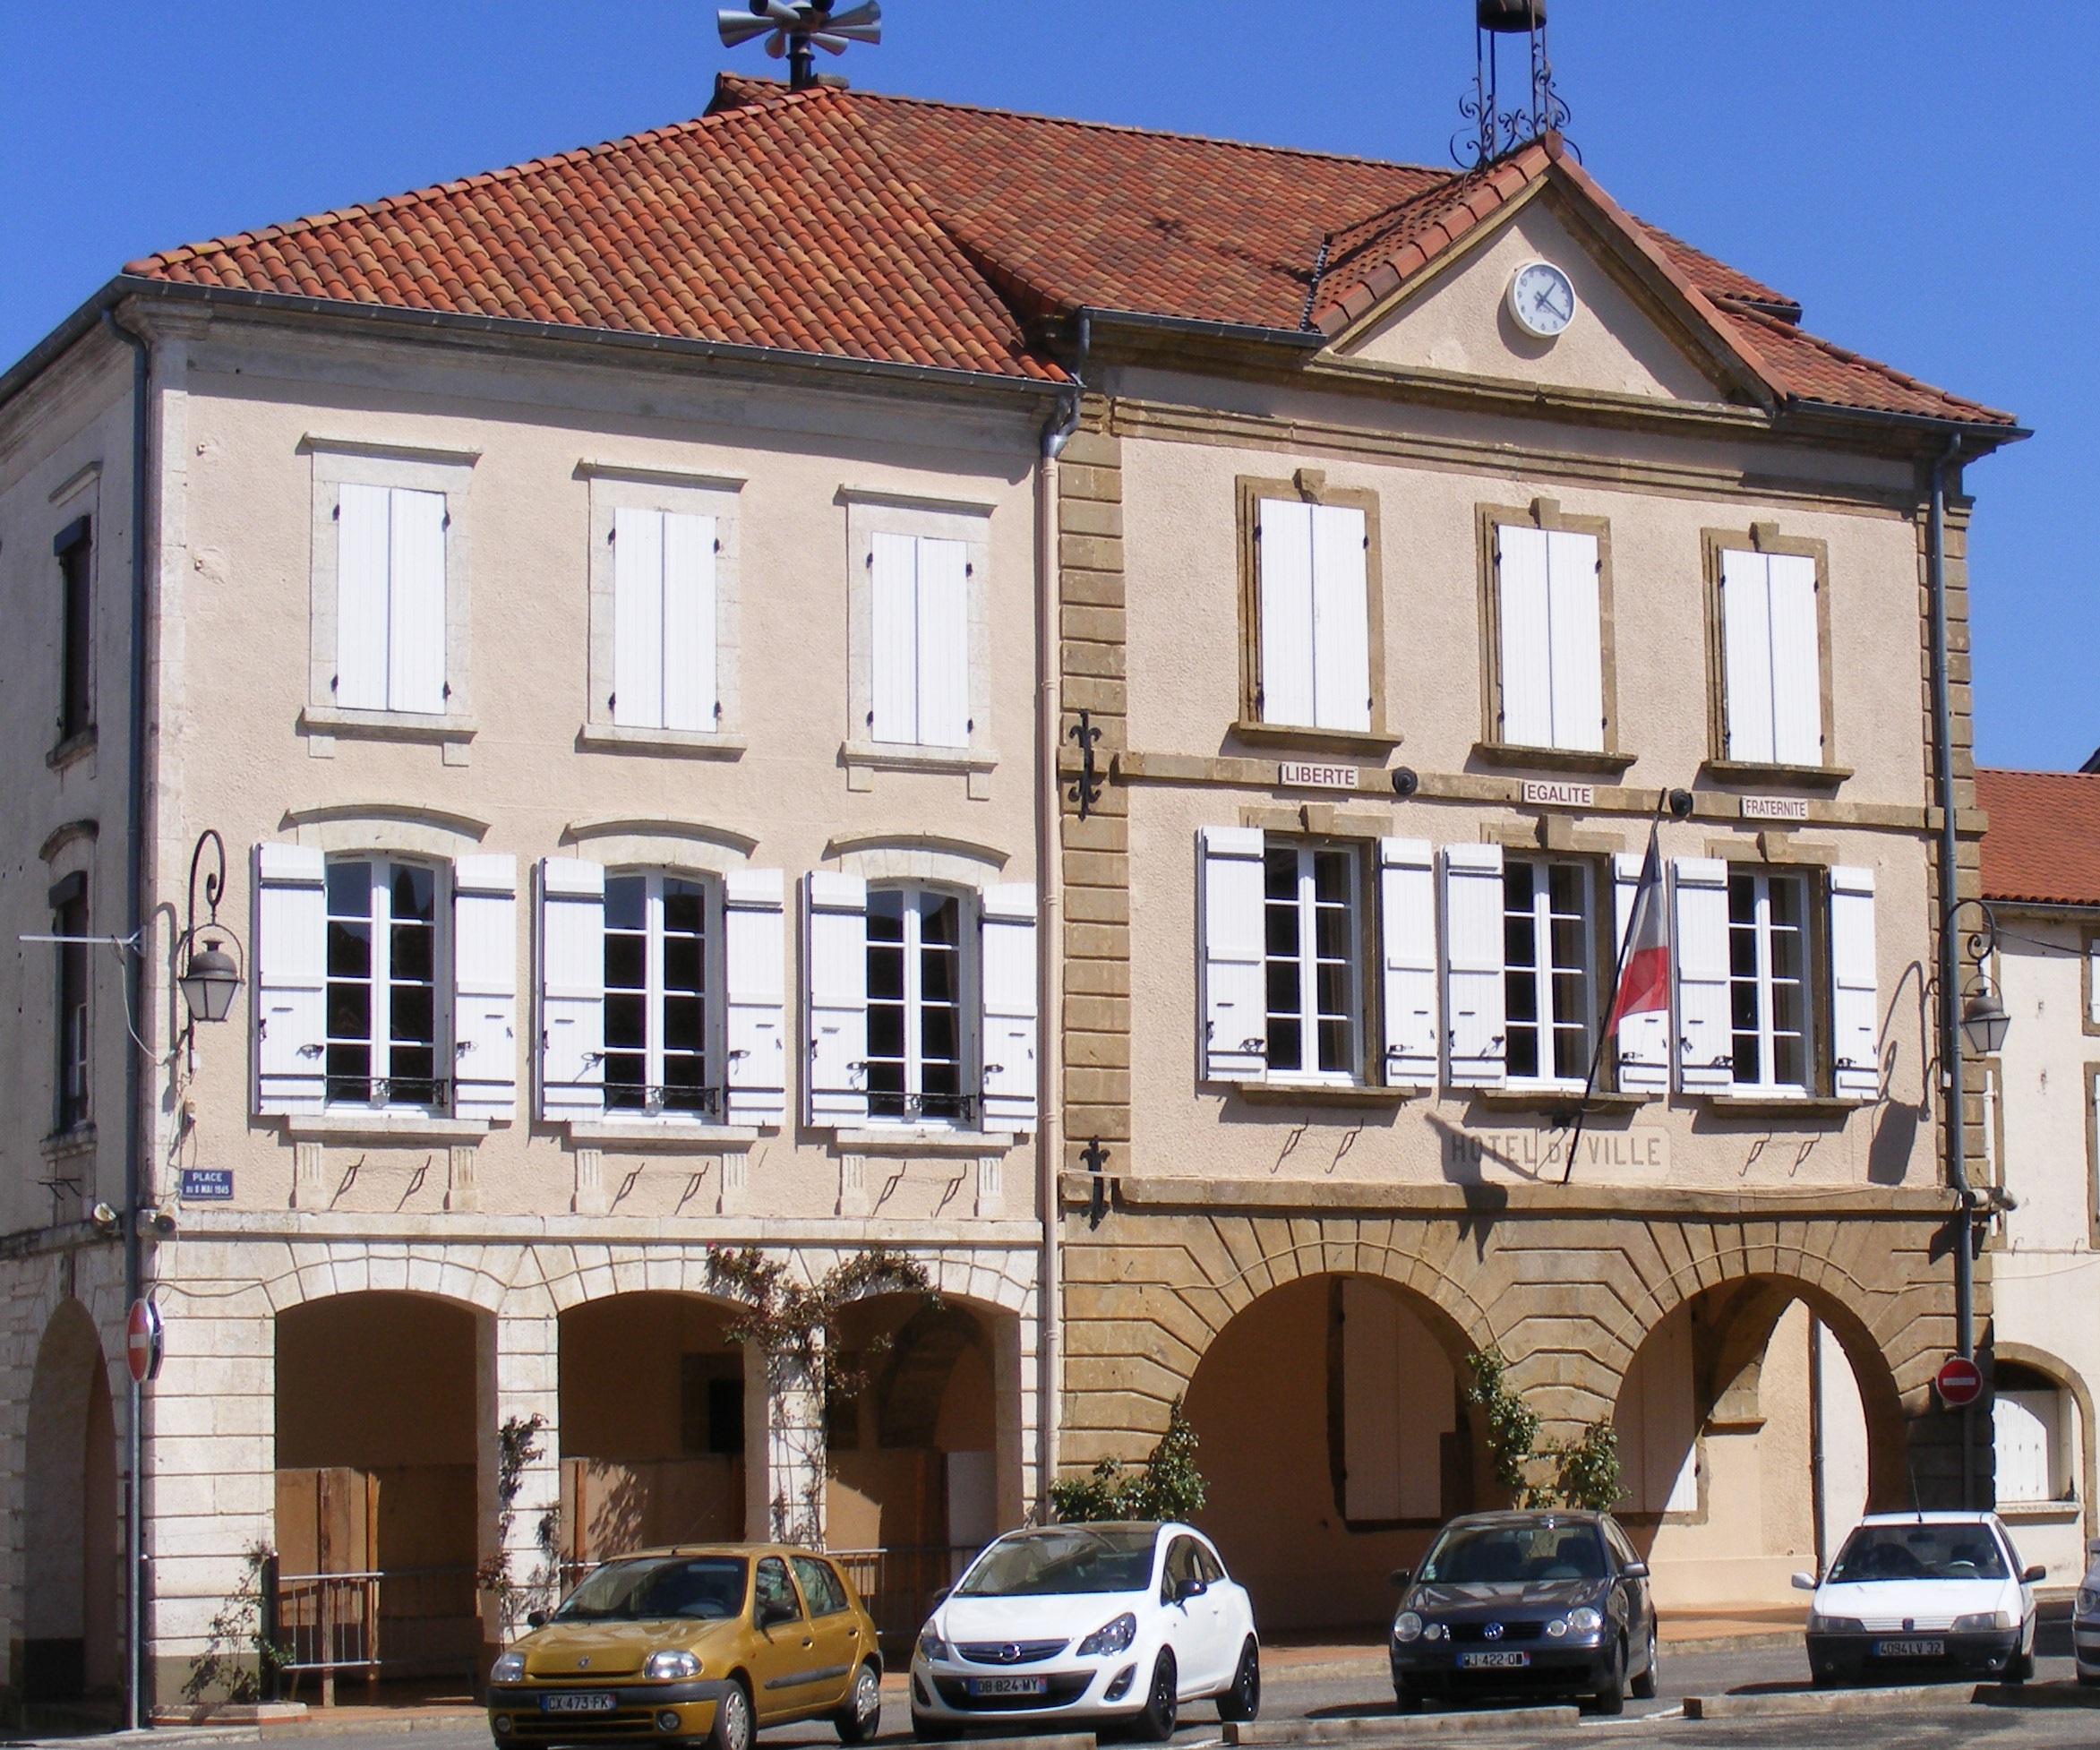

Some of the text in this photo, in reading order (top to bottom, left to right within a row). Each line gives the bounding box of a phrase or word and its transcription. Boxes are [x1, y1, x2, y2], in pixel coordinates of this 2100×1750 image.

[1286, 766, 1355, 785] LIBERTE
[1528, 785, 1590, 803] EGALITE
[1745, 800, 1806, 817] FRATERNITE
[1452, 1134, 1537, 1163] HOTEL
[1587, 1137, 1661, 1166] VILLE
[193, 1172, 223, 1182] PLACE
